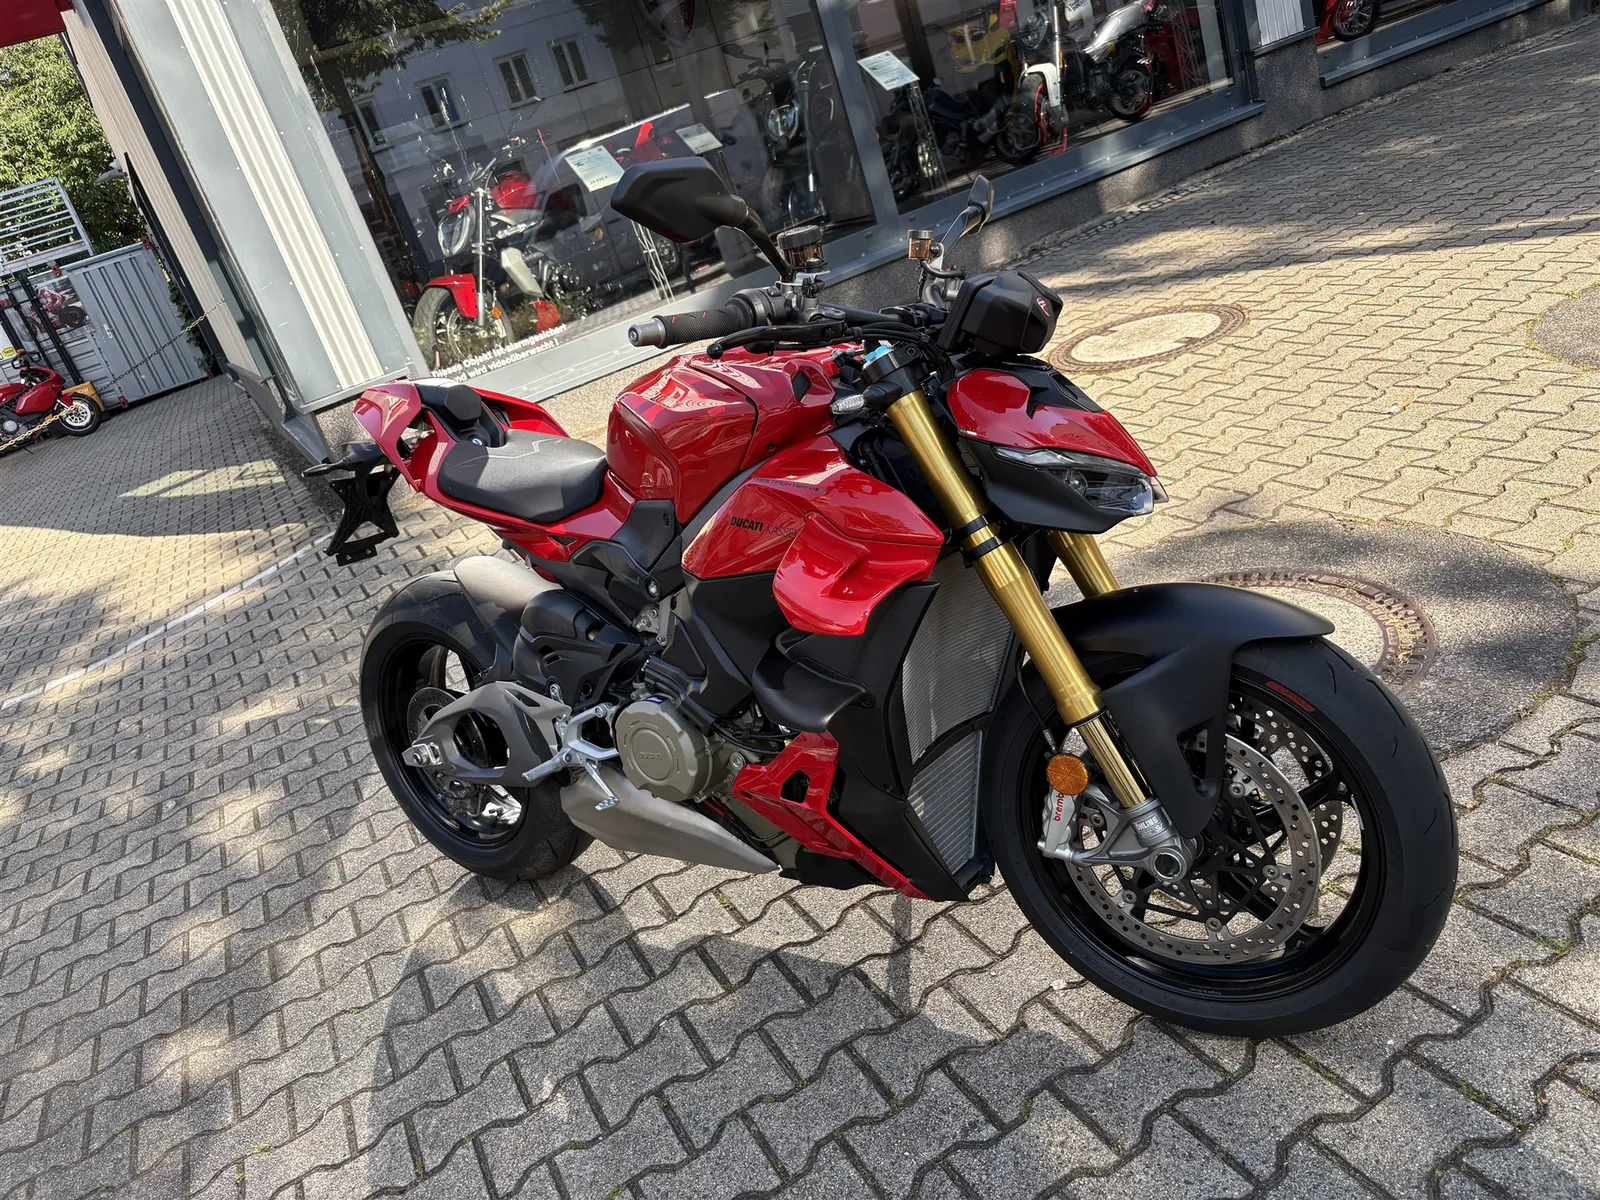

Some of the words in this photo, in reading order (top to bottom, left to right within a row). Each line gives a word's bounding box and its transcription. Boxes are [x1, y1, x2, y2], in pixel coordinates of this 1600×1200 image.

[431, 364, 463, 378] Dieses
[463, 350, 493, 367] Objekt
[493, 346, 506, 358] ist
[506, 323, 567, 353] alarmgesichert
[468, 365, 488, 378] wird
[488, 340, 555, 370] videoüberwacht
[730, 516, 764, 532] DUCATI
[1052, 791, 1065, 822] bremb
